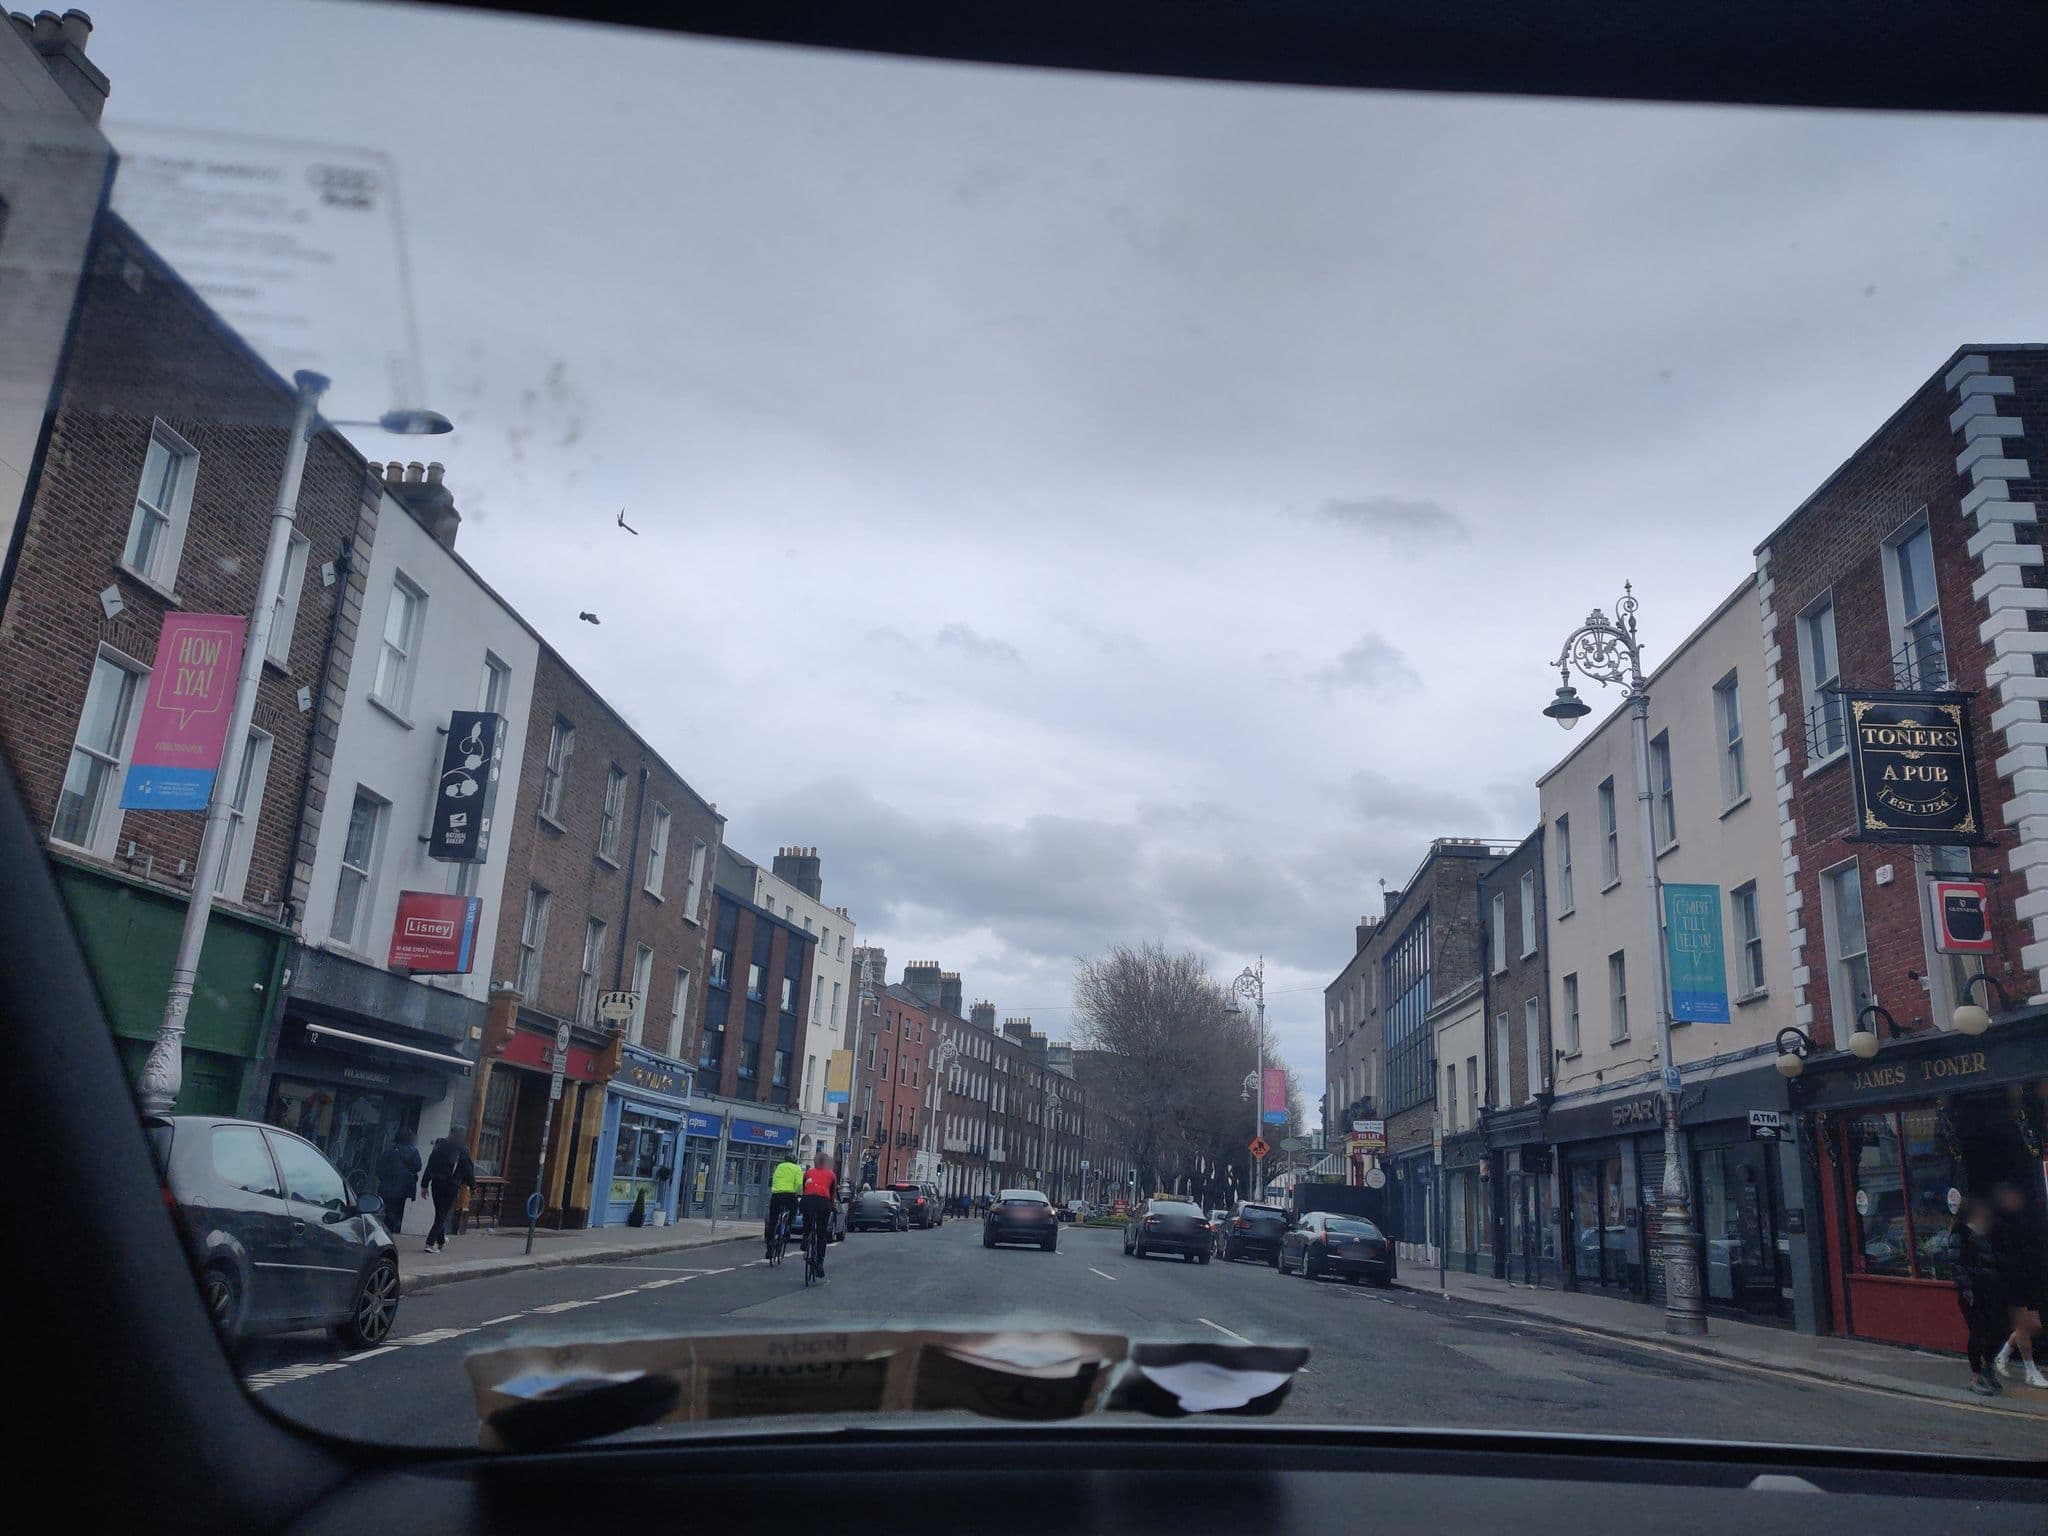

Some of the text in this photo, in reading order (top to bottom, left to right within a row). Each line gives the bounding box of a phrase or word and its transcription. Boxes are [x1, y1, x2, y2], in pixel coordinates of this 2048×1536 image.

[179, 637, 222, 667] HOW
[173, 667, 213, 698] IYA!
[1862, 728, 1958, 746] TONERS
[1882, 764, 1948, 782] A PUB
[1889, 797, 1917, 813] EST.
[409, 921, 450, 936] Lisney
[1669, 1069, 1678, 1084] P
[1853, 1052, 1987, 1090] JAMES TONER
[1611, 1100, 1653, 1126] SPAR
[1752, 1113, 1778, 1123] ATM
